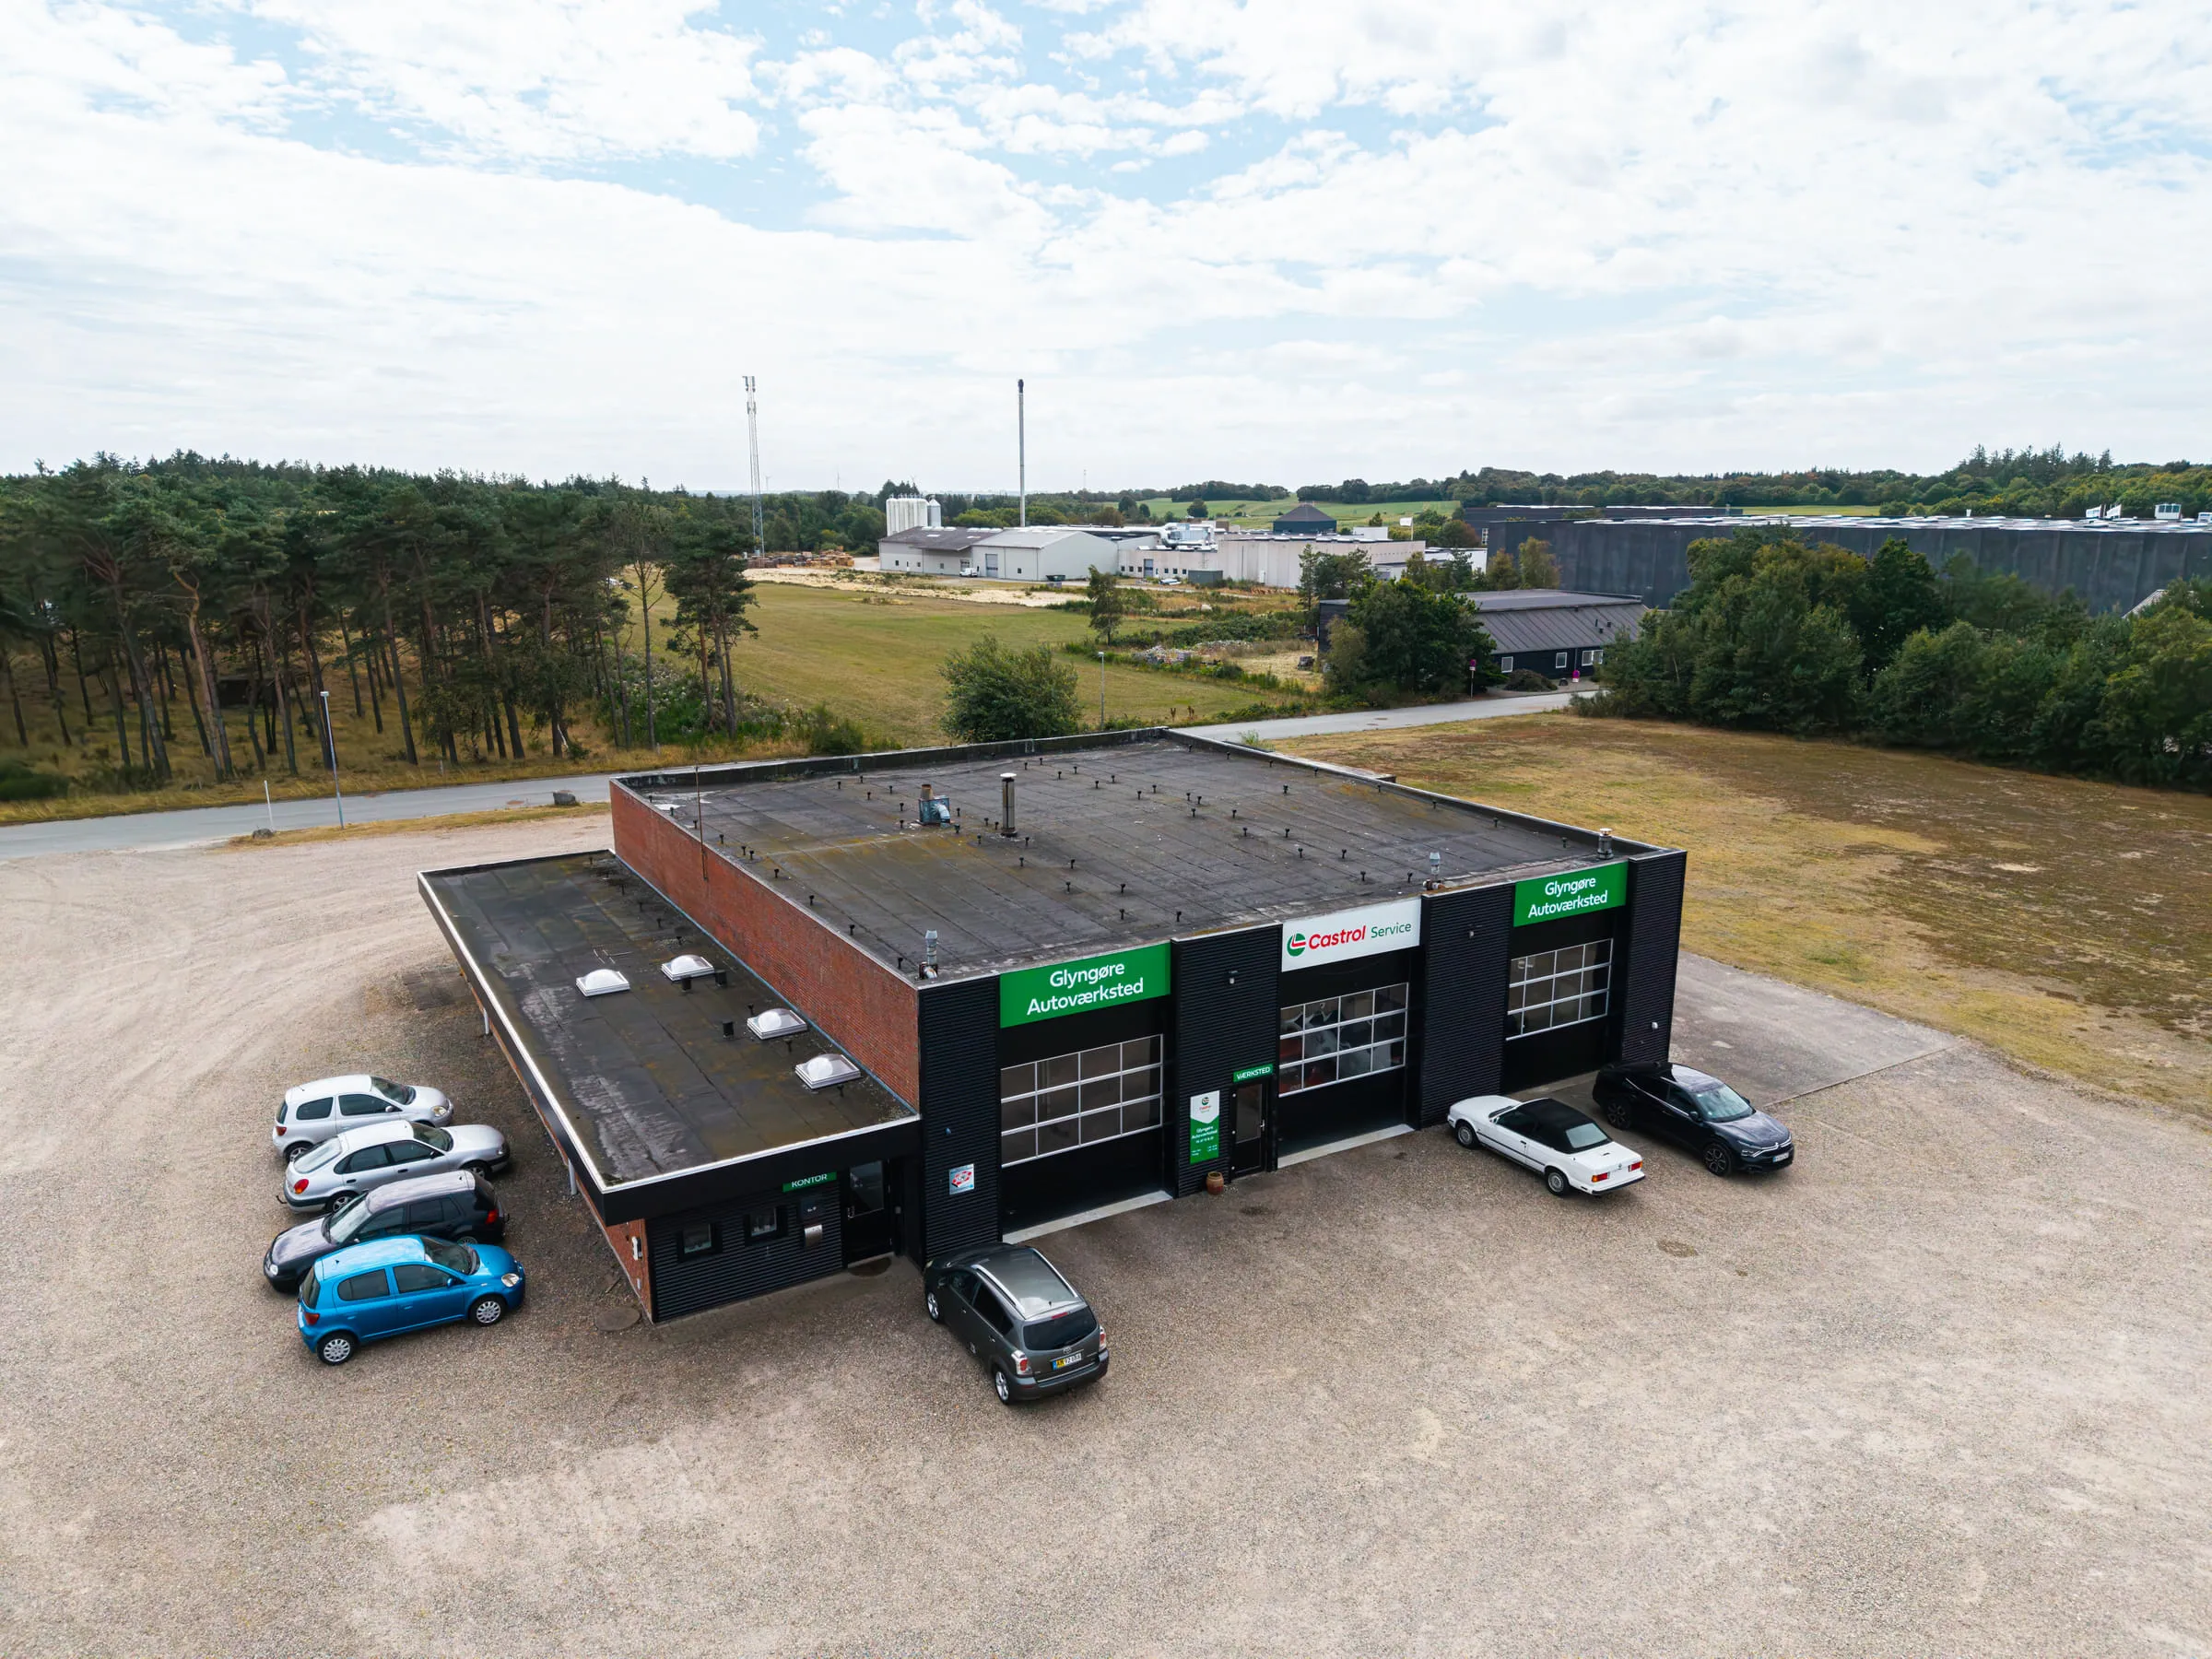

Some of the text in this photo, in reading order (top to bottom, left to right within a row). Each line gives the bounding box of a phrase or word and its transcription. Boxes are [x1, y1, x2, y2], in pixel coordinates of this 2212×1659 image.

[1545, 877, 1596, 898] Glyngøre
[1527, 889, 1608, 919] Autoværksted
[1309, 922, 1412, 950] Castrol Service
[1049, 963, 1125, 989] Glyngøre
[1026, 977, 1144, 1016] Autoværksted
[791, 1173, 828, 1188] KONTOR
